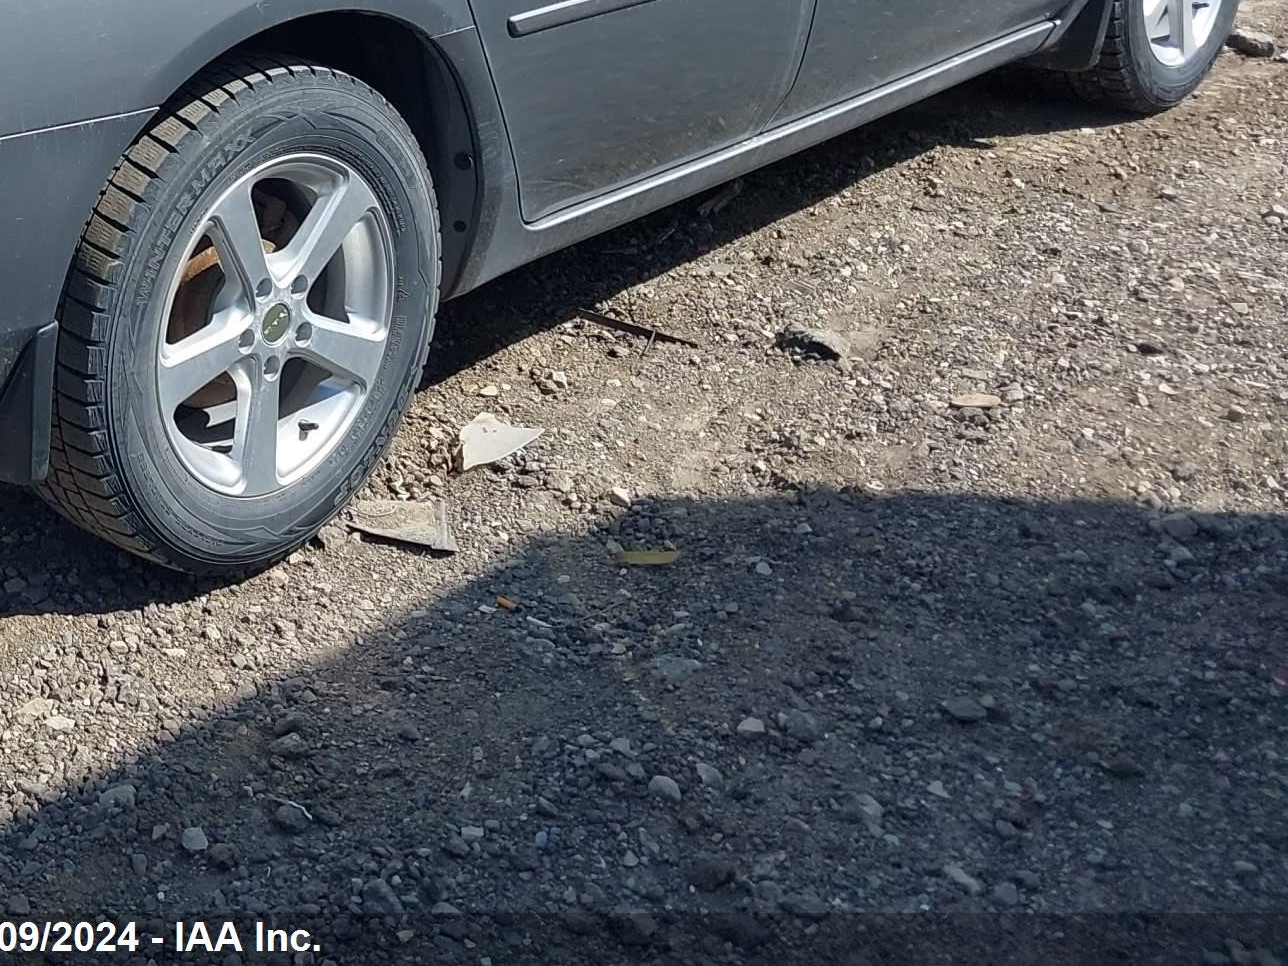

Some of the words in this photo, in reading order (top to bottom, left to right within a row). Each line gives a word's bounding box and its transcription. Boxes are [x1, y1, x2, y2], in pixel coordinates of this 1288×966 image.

[136, 192, 194, 307] WINTER
[190, 130, 257, 196] MAXX
[335, 384, 408, 505] DUNLOP
